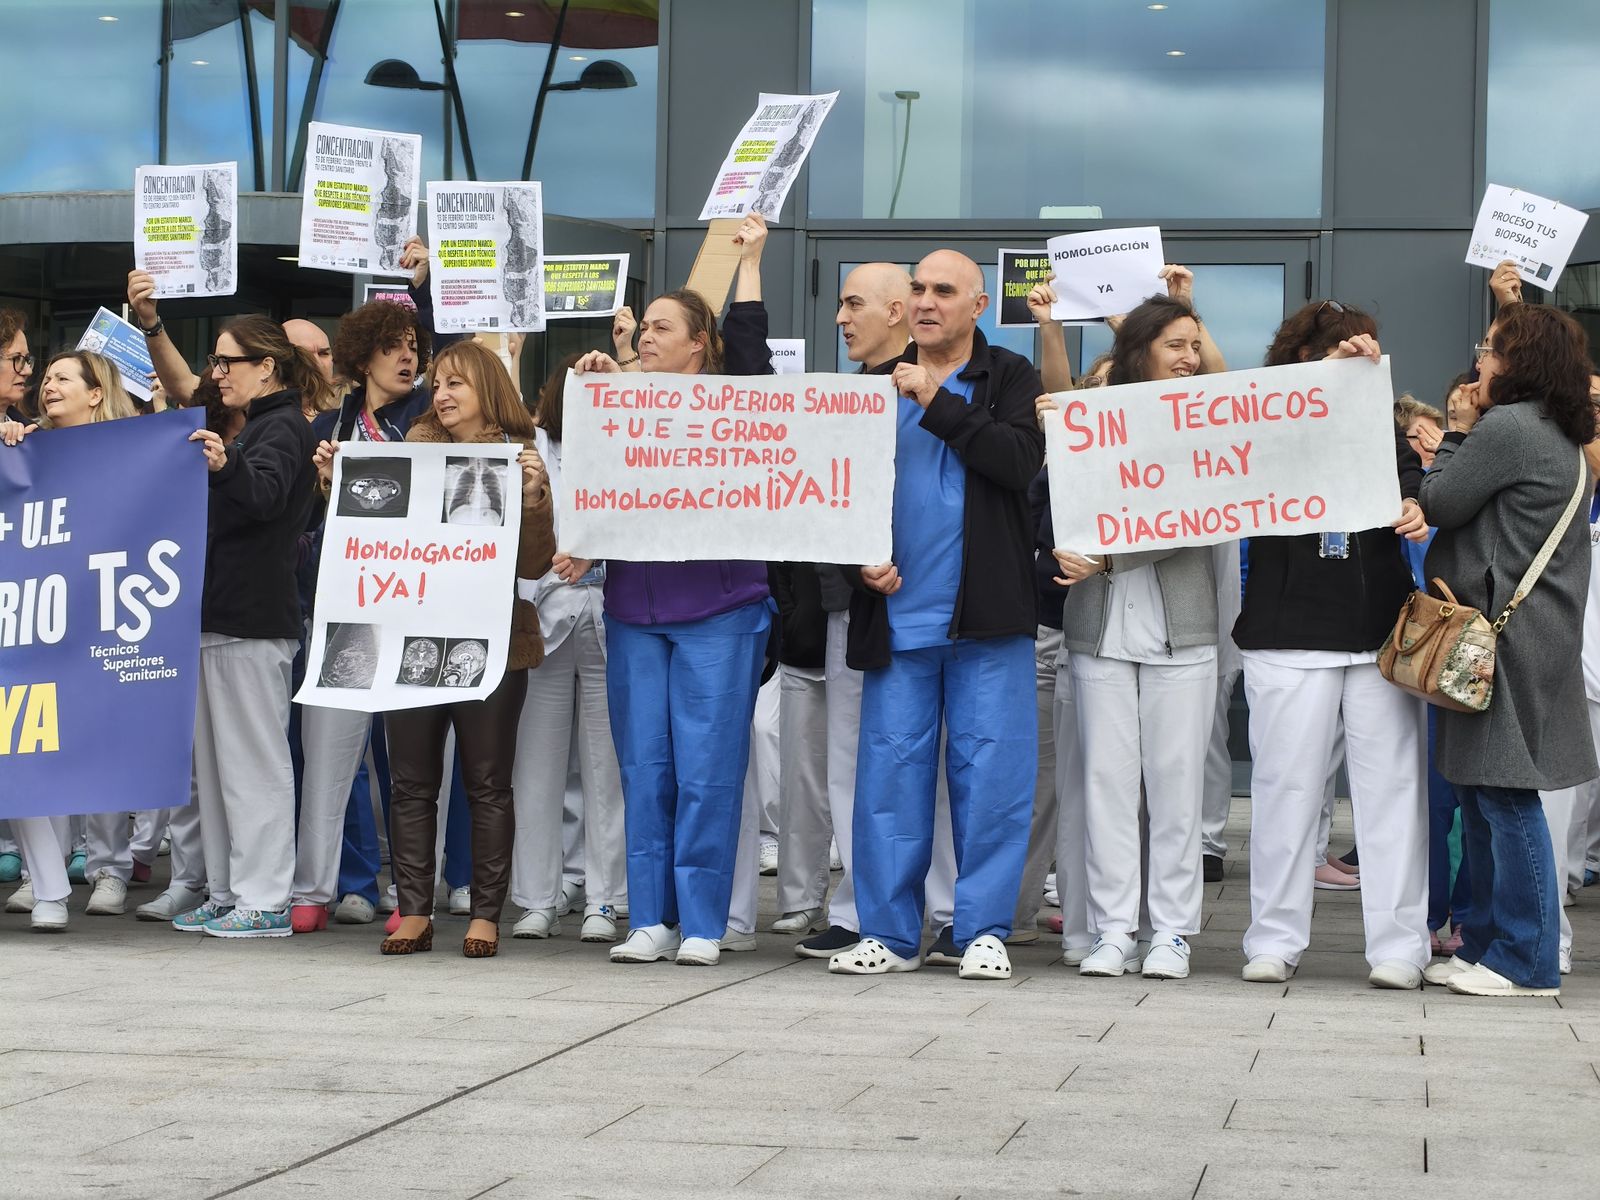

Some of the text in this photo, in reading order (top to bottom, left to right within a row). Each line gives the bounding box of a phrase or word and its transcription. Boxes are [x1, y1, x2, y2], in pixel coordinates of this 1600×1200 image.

[316, 134, 374, 160] CONCENTRACIÓN
[1522, 202, 1536, 213] YO
[1491, 210, 1558, 239] PROCESO TUS
[1494, 227, 1539, 249] BIOPSIAS
[1054, 241, 1149, 261] HOMOLOGACIÓN
[1014, 258, 1029, 268] POR
[1030, 258, 1039, 268] UN
[1025, 270, 1039, 280] QUE
[1097, 284, 1114, 294] YA
[804, 387, 886, 415] SANIDAD
[711, 418, 788, 443] GRADO
[1063, 401, 1128, 453] SIN
[625, 446, 797, 468] UNIVERSITARIO
[1119, 460, 1166, 490] NO
[20, 496, 72, 549] U.E.
[88, 538, 182, 643] TSS
[90, 644, 139, 658] Técnicos
[103, 655, 164, 673] Superiores
[119, 666, 178, 683] Sanitarios
